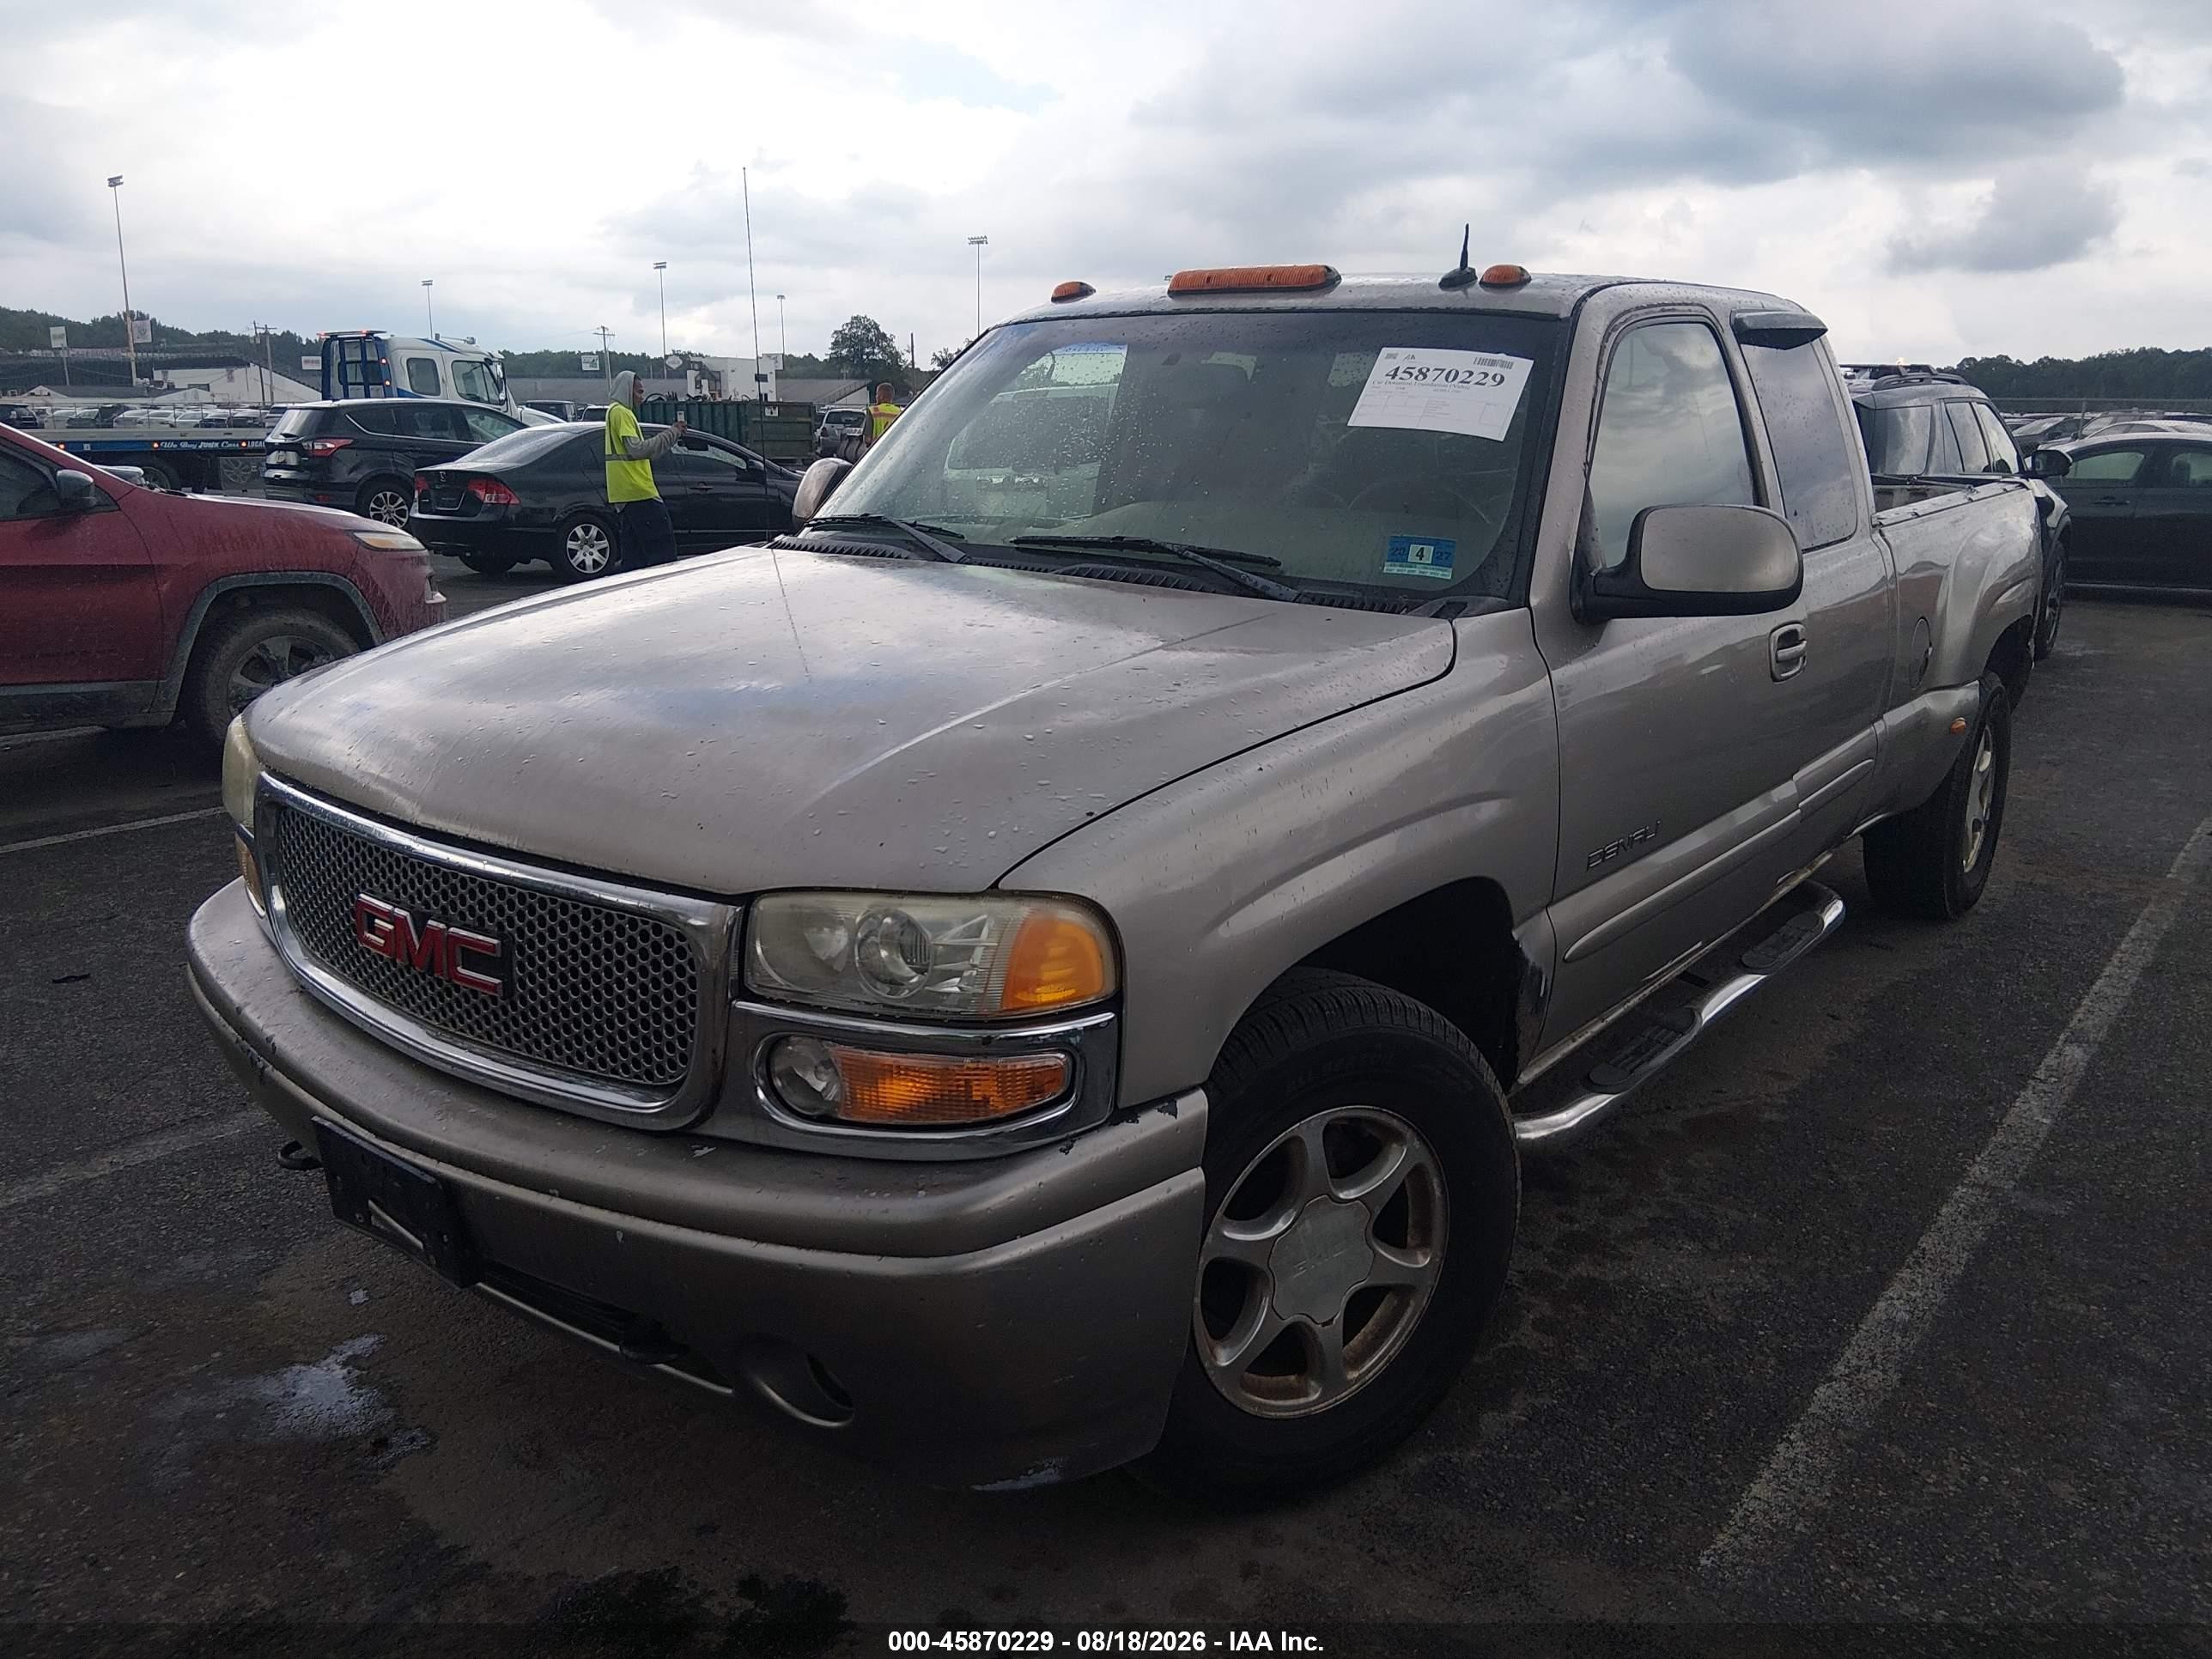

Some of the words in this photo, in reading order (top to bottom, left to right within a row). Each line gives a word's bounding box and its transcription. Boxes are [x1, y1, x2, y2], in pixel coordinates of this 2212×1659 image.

[1385, 365, 1505, 387] 45870229
[1416, 547, 1425, 561] 4
[356, 892, 503, 996] GMC
